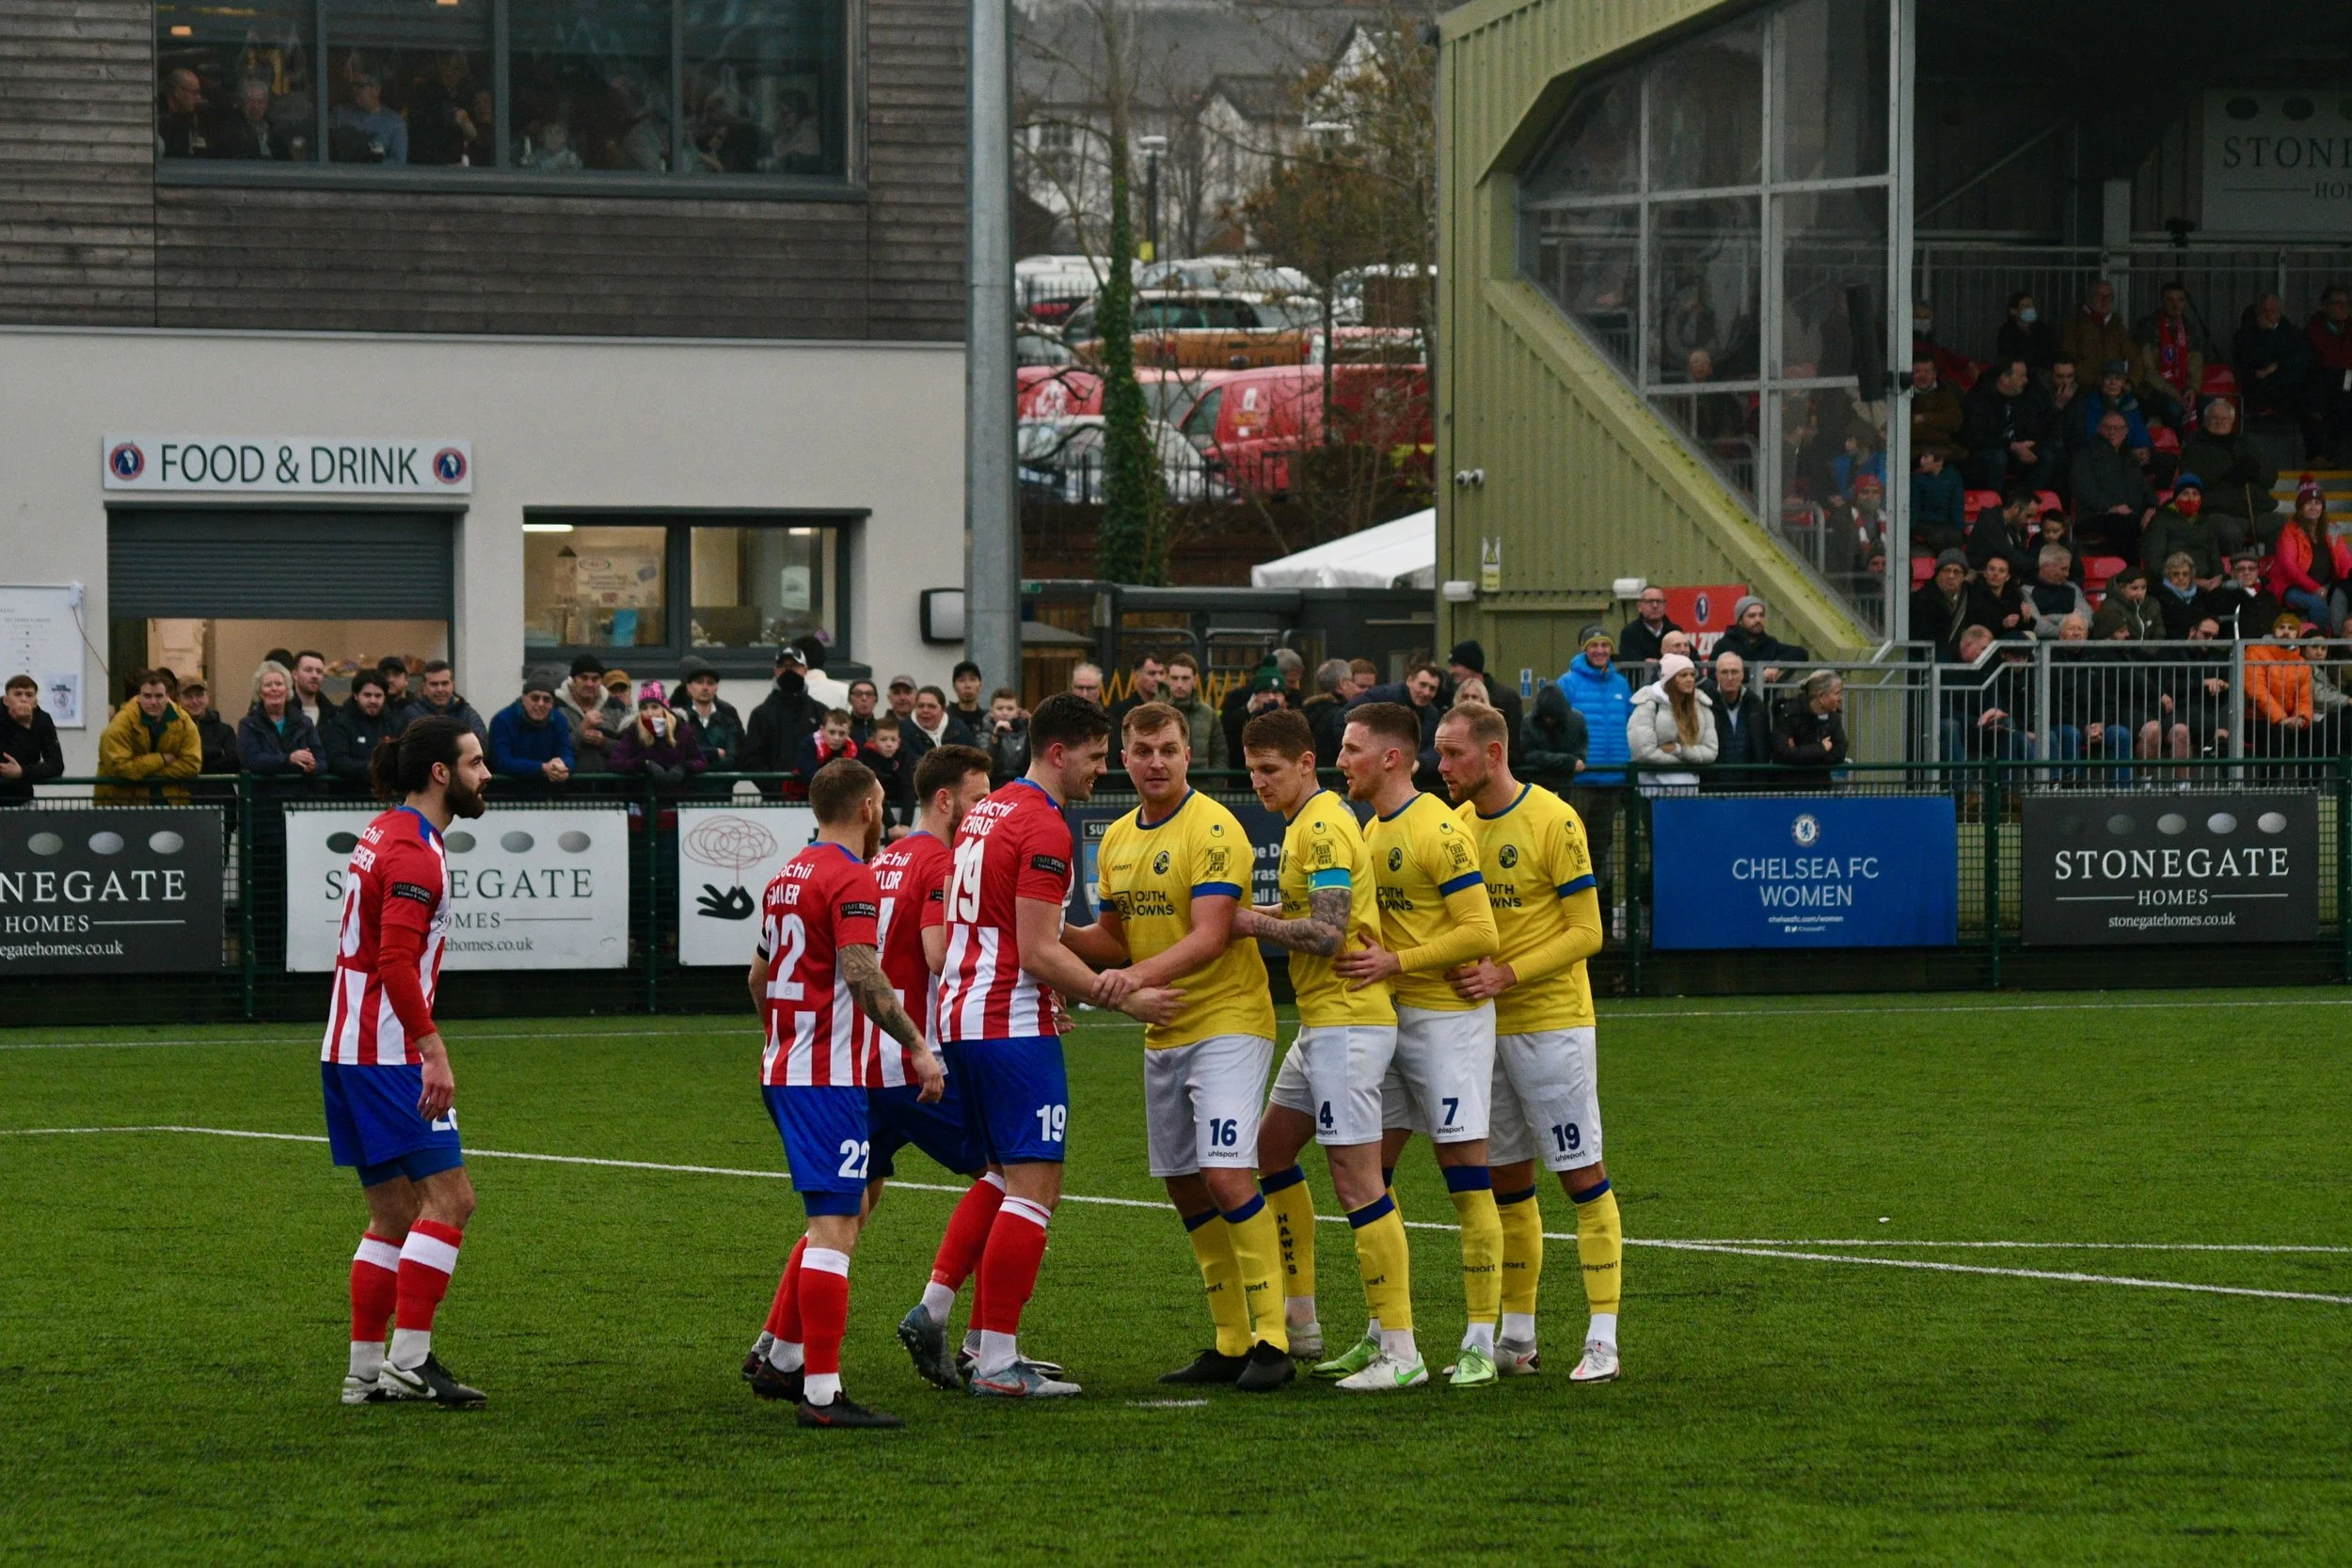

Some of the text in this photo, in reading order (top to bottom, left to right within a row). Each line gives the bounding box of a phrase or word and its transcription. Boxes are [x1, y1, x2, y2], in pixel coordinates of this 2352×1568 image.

[2315, 182, 2352, 198] HO
[161, 443, 419, 484] FOOD & DRINK
[1732, 857, 1879, 879] CHELSEA FC
[2055, 847, 2289, 879] STONEGATE
[326, 869, 594, 901] SEGATE
[946, 836, 984, 924] 19
[1136, 890, 1167, 902] OUTH
[1759, 885, 1852, 907] WOMEN
[2137, 889, 2209, 906] HOMES
[4, 915, 89, 932] HOMES
[2108, 911, 2236, 929] stonegatehomes.co.uk
[765, 912, 806, 1001] 22
[1037, 1104, 1067, 1142] 19
[1320, 1101, 1333, 1128] 4
[1442, 1097, 1458, 1126] 7
[1210, 1118, 1237, 1147] 16
[1552, 1123, 1580, 1152] 19
[1555, 1150, 1585, 1163] uhlsport
[1278, 1212, 1297, 1275] HAWKS
